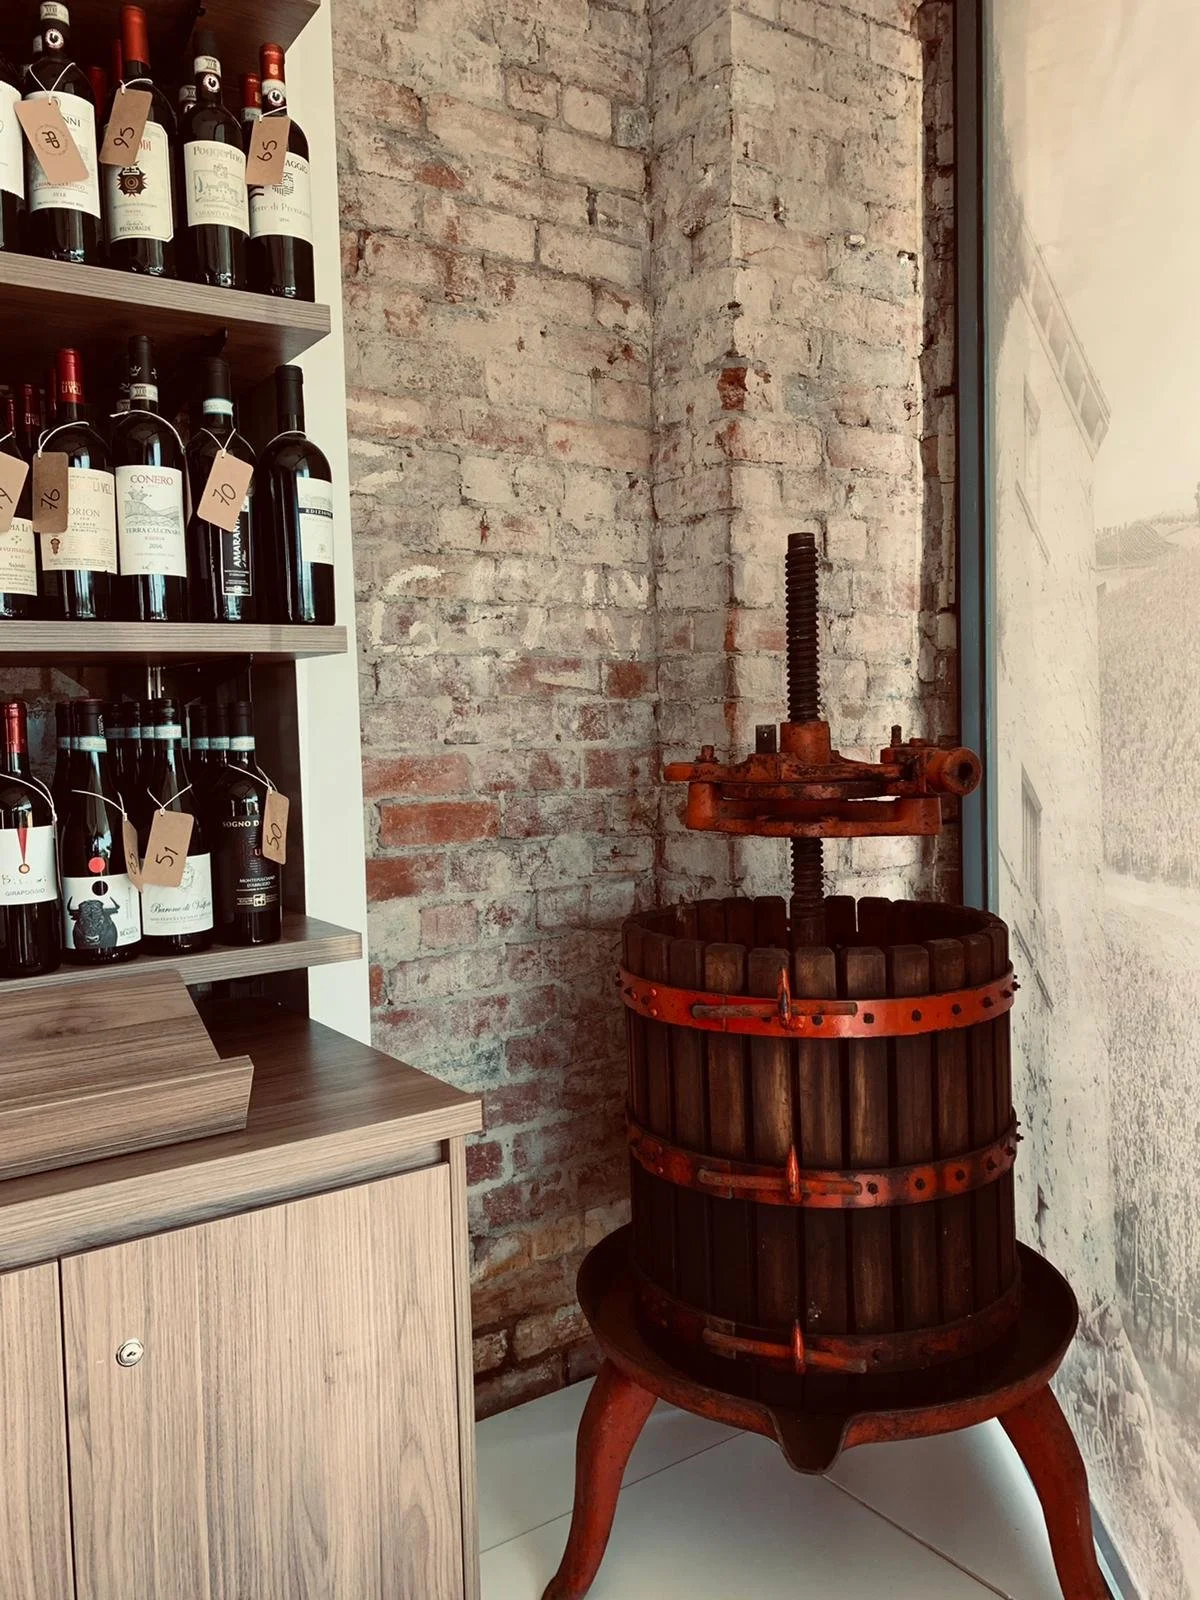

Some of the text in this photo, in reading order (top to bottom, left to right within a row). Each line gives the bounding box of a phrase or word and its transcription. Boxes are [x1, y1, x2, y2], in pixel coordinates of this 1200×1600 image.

[113, 126, 135, 148] 95
[257, 139, 282, 162] 65
[130, 474, 174, 487] CONERO
[41, 488, 60, 509] 76
[212, 483, 236, 506] 70
[223, 820, 251, 828] SOGNO
[266, 822, 283, 851] 50
[155, 846, 178, 868] 51
